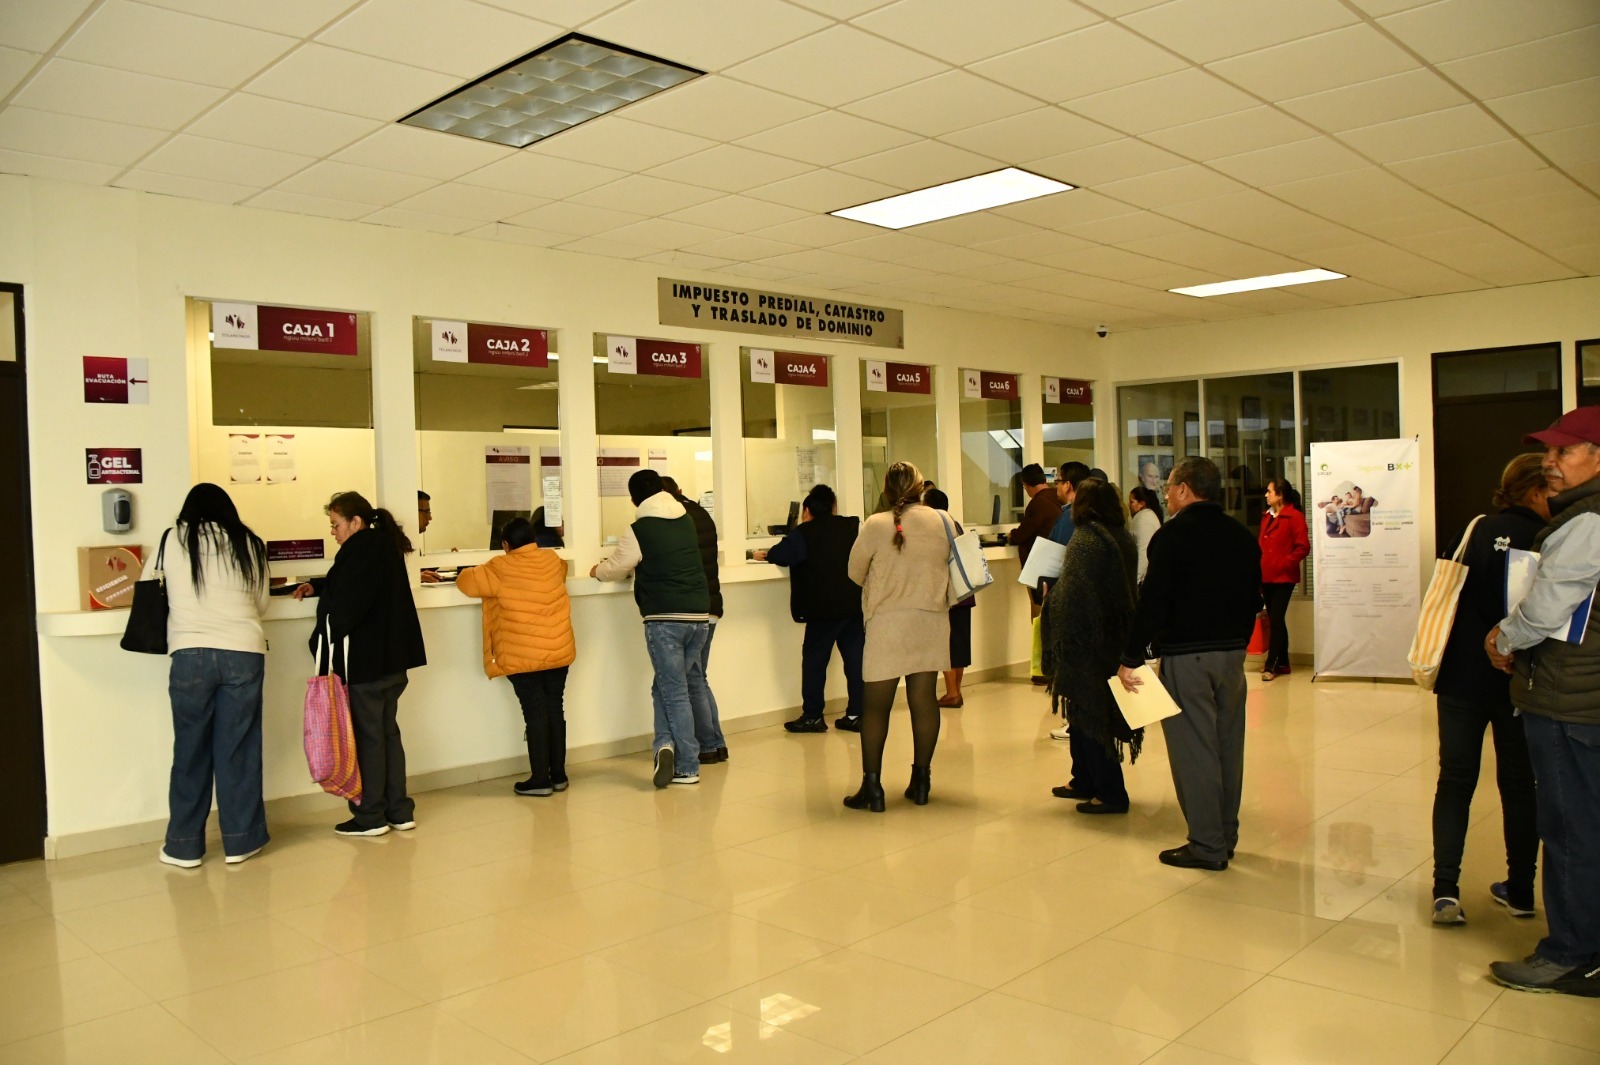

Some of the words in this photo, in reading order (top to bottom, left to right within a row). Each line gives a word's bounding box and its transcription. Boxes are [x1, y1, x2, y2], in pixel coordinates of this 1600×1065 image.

[672, 283, 749, 306] IMPUESTO
[758, 294, 820, 318] PREDIAL,
[824, 303, 885, 323] CATASTRO
[691, 304, 702, 318] Y
[711, 306, 788, 328] TRASLADO
[796, 316, 812, 331] DE
[818, 319, 873, 338] DOMINIO
[282, 322, 323, 337] CAJA
[326, 322, 335, 338] 1
[486, 339, 520, 352] CAJA
[520, 338, 531, 352] 2
[651, 352, 678, 364] CAJA
[679, 352, 687, 364] 3
[787, 363, 809, 374] CAJA
[809, 363, 817, 375] 4
[896, 373, 915, 383] CAJA
[915, 372, 921, 383] 5
[989, 381, 1005, 390] CAJA
[1004, 380, 1010, 390] 6
[1066, 387, 1080, 395] CAJA
[1079, 387, 1084, 396] 7
[101, 456, 132, 469] GEL
